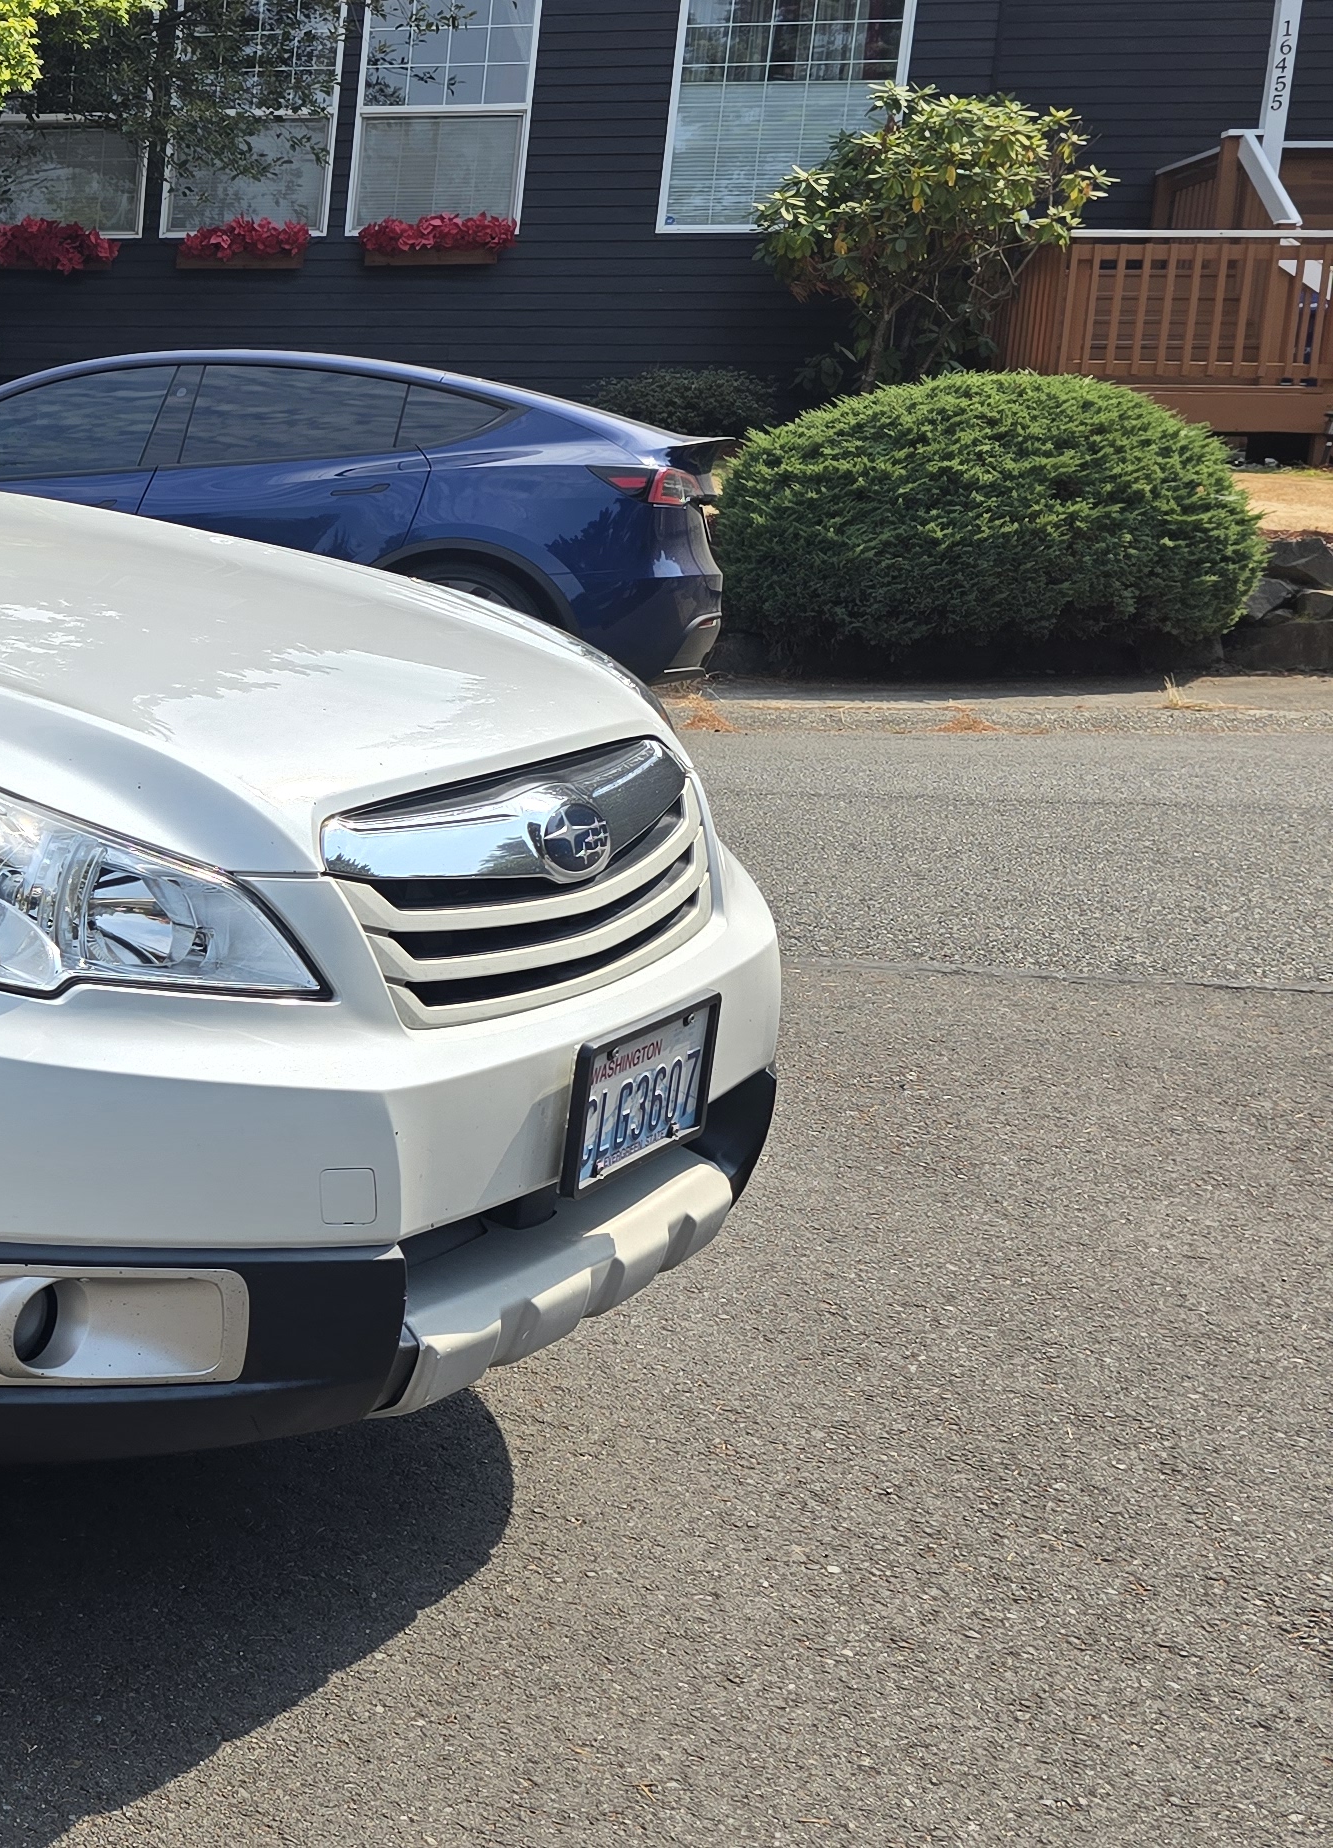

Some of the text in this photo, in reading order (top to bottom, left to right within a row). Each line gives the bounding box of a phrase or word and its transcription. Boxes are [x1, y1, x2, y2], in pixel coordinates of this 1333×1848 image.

[1270, 20, 1292, 111] 16455
[590, 1039, 663, 1085] WASHINGTON
[581, 1049, 701, 1166] CLG3607
[603, 1130, 666, 1167] EVERGREEN STATE
